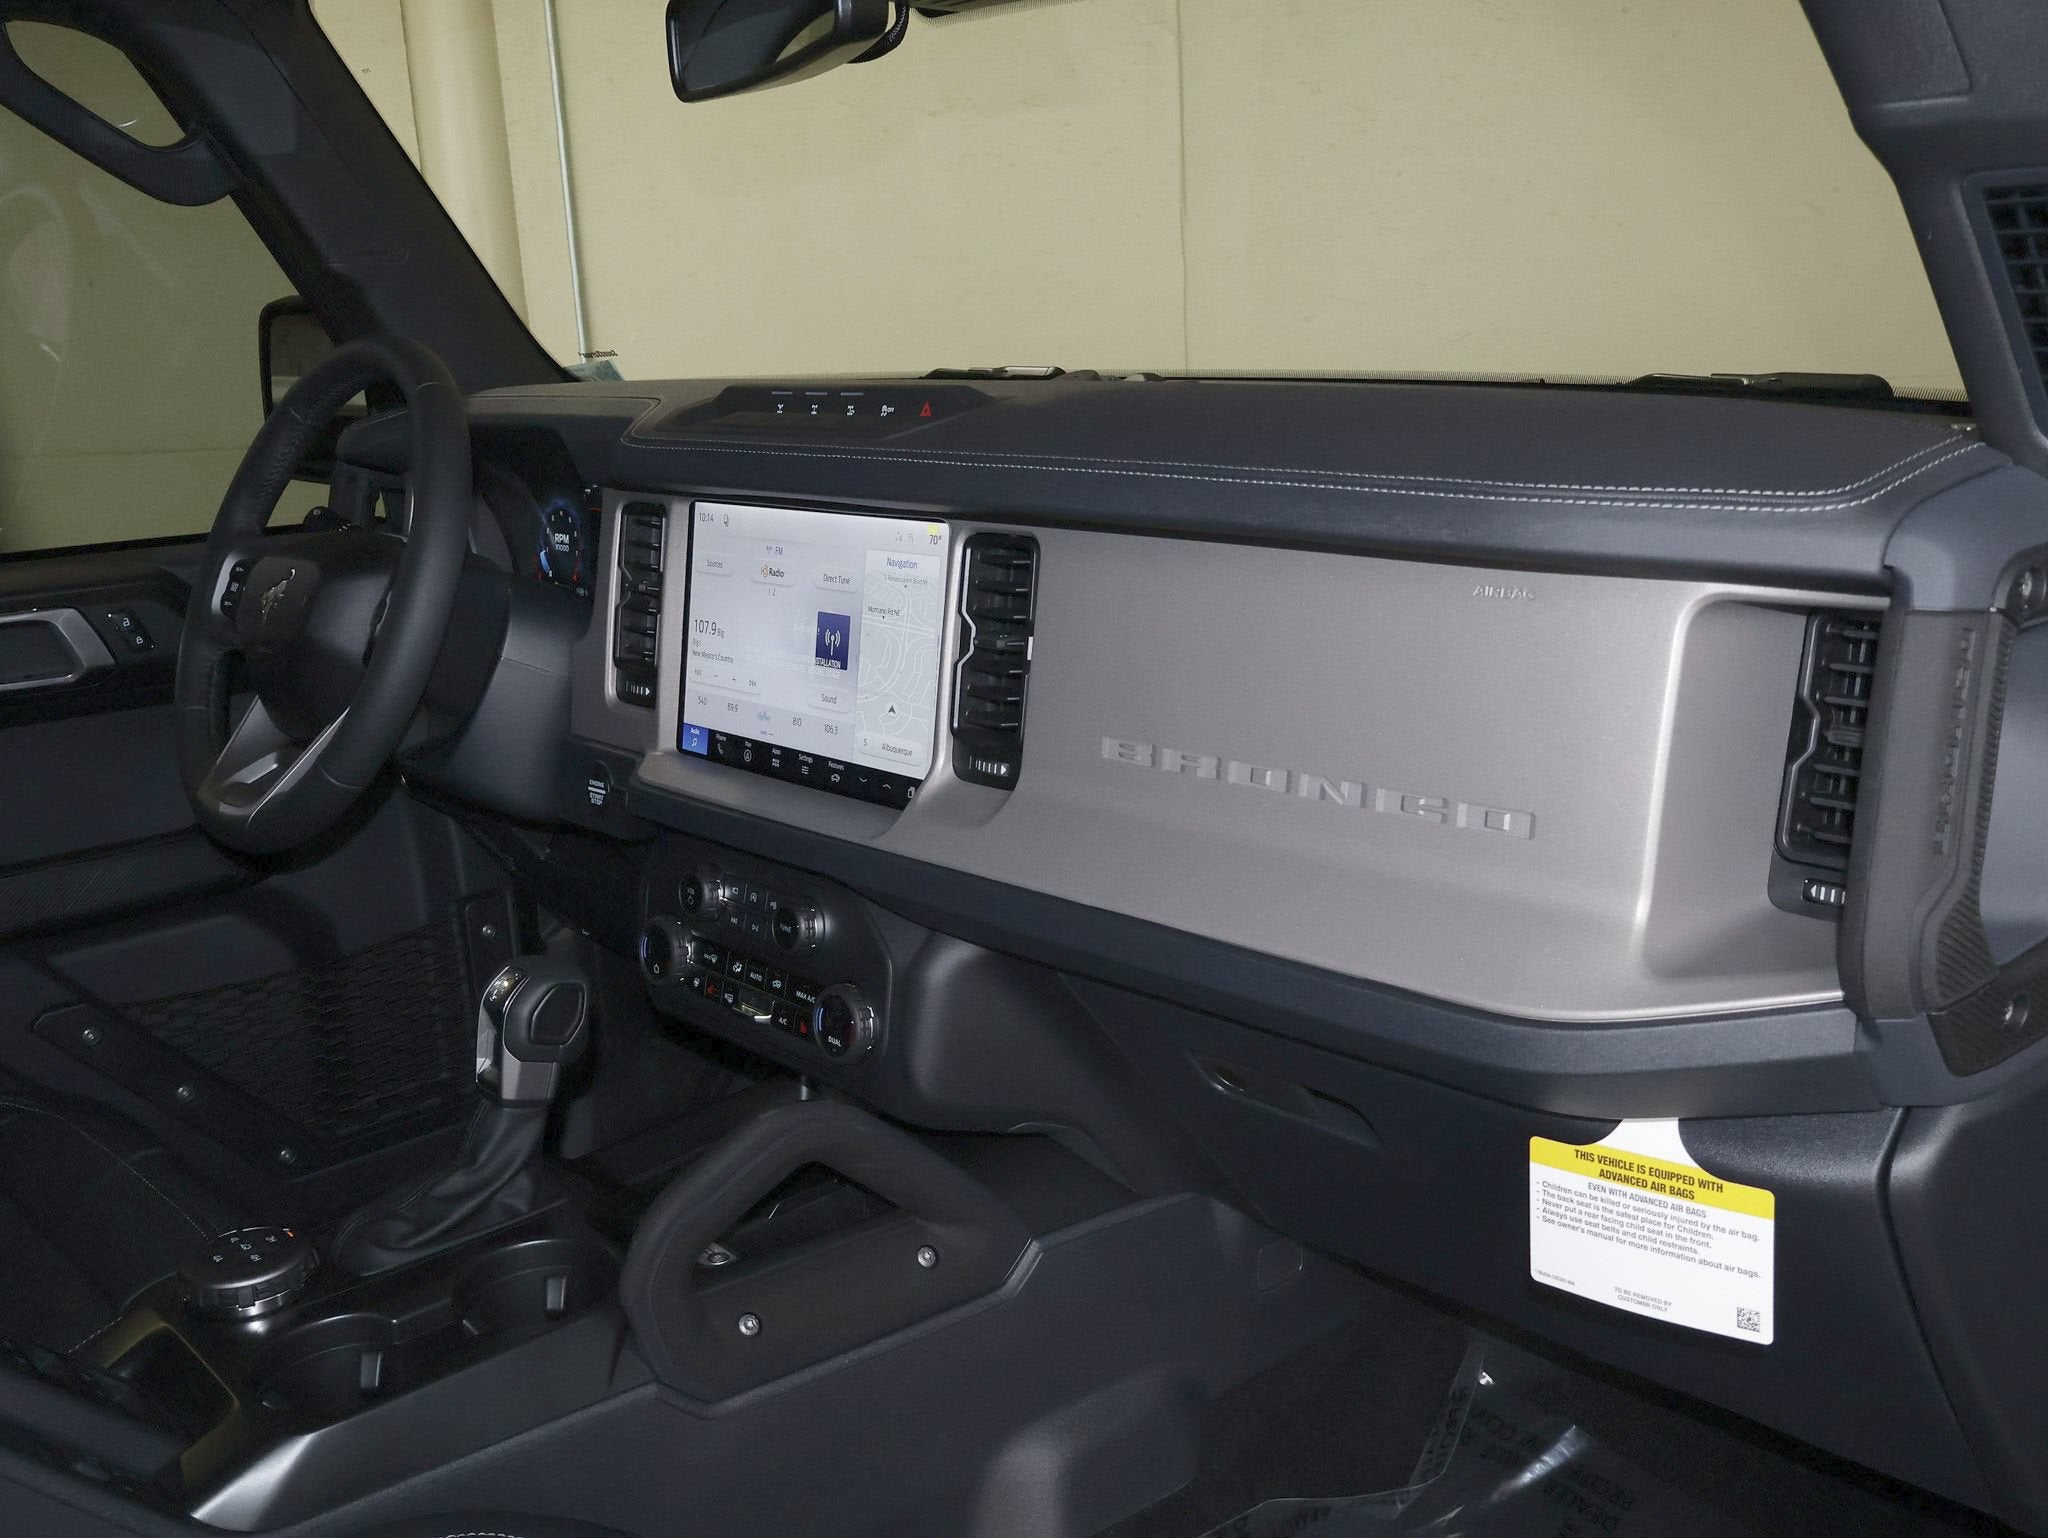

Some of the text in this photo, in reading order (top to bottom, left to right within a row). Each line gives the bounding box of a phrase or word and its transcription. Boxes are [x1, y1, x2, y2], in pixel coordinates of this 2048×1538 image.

[699, 512, 714, 522] 10:14
[554, 533, 570, 544] RPM
[886, 557, 918, 570] Navigation
[768, 567, 786, 578] Radio
[823, 573, 851, 585] Direct Tune
[694, 619, 717, 635] 107.9
[821, 693, 838, 705] Sound
[824, 723, 839, 735] 106.3
[881, 742, 913, 757] Albuquerque
[1101, 735, 1536, 840] BRONCO
[750, 971, 763, 982] AUTO
[828, 1035, 842, 1048] DUAL
[1574, 1149, 1724, 1193] THIS VEHICLE IS EQUIPPED WITH
[1598, 1168, 1695, 1200] ADVANCED AIR BAGS
[1588, 1182, 1707, 1219] EVEN WITH ADVANCED AIR BAGS
[1542, 1180, 1572, 1194] Children
[1574, 1190, 1587, 1198] can
[1589, 1192, 1598, 1201] be
[1600, 1195, 1620, 1207] killed
[1632, 1204, 1668, 1221] seriously
[1670, 1213, 1699, 1227] injured
[1701, 1219, 1711, 1231] by
[1713, 1224, 1726, 1234] the
[1728, 1228, 1739, 1236] air
[1741, 1230, 1760, 1242] bag.
[1542, 1189, 1714, 1240] The back seat is the safest place for Children.
[1542, 1198, 1563, 1209] Never
[1564, 1205, 1577, 1215] put
[1584, 1210, 1599, 1219] rear
[1600, 1214, 1624, 1228] facing
[1626, 1220, 1645, 1232] child
[1647, 1226, 1663, 1237] seat
[1665, 1229, 1673, 1239] in
[1675, 1232, 1688, 1243] the
[1689, 1236, 1712, 1249] front.
[1542, 1207, 1700, 1255] Always use seat belts and child restraints.
[1542, 1215, 1761, 1279] See owner's manual for more information about air bags.
[1617, 1294, 1668, 1312] CUSTOMER ONLY
[1632, 1292, 1663, 1305] REMOVED
